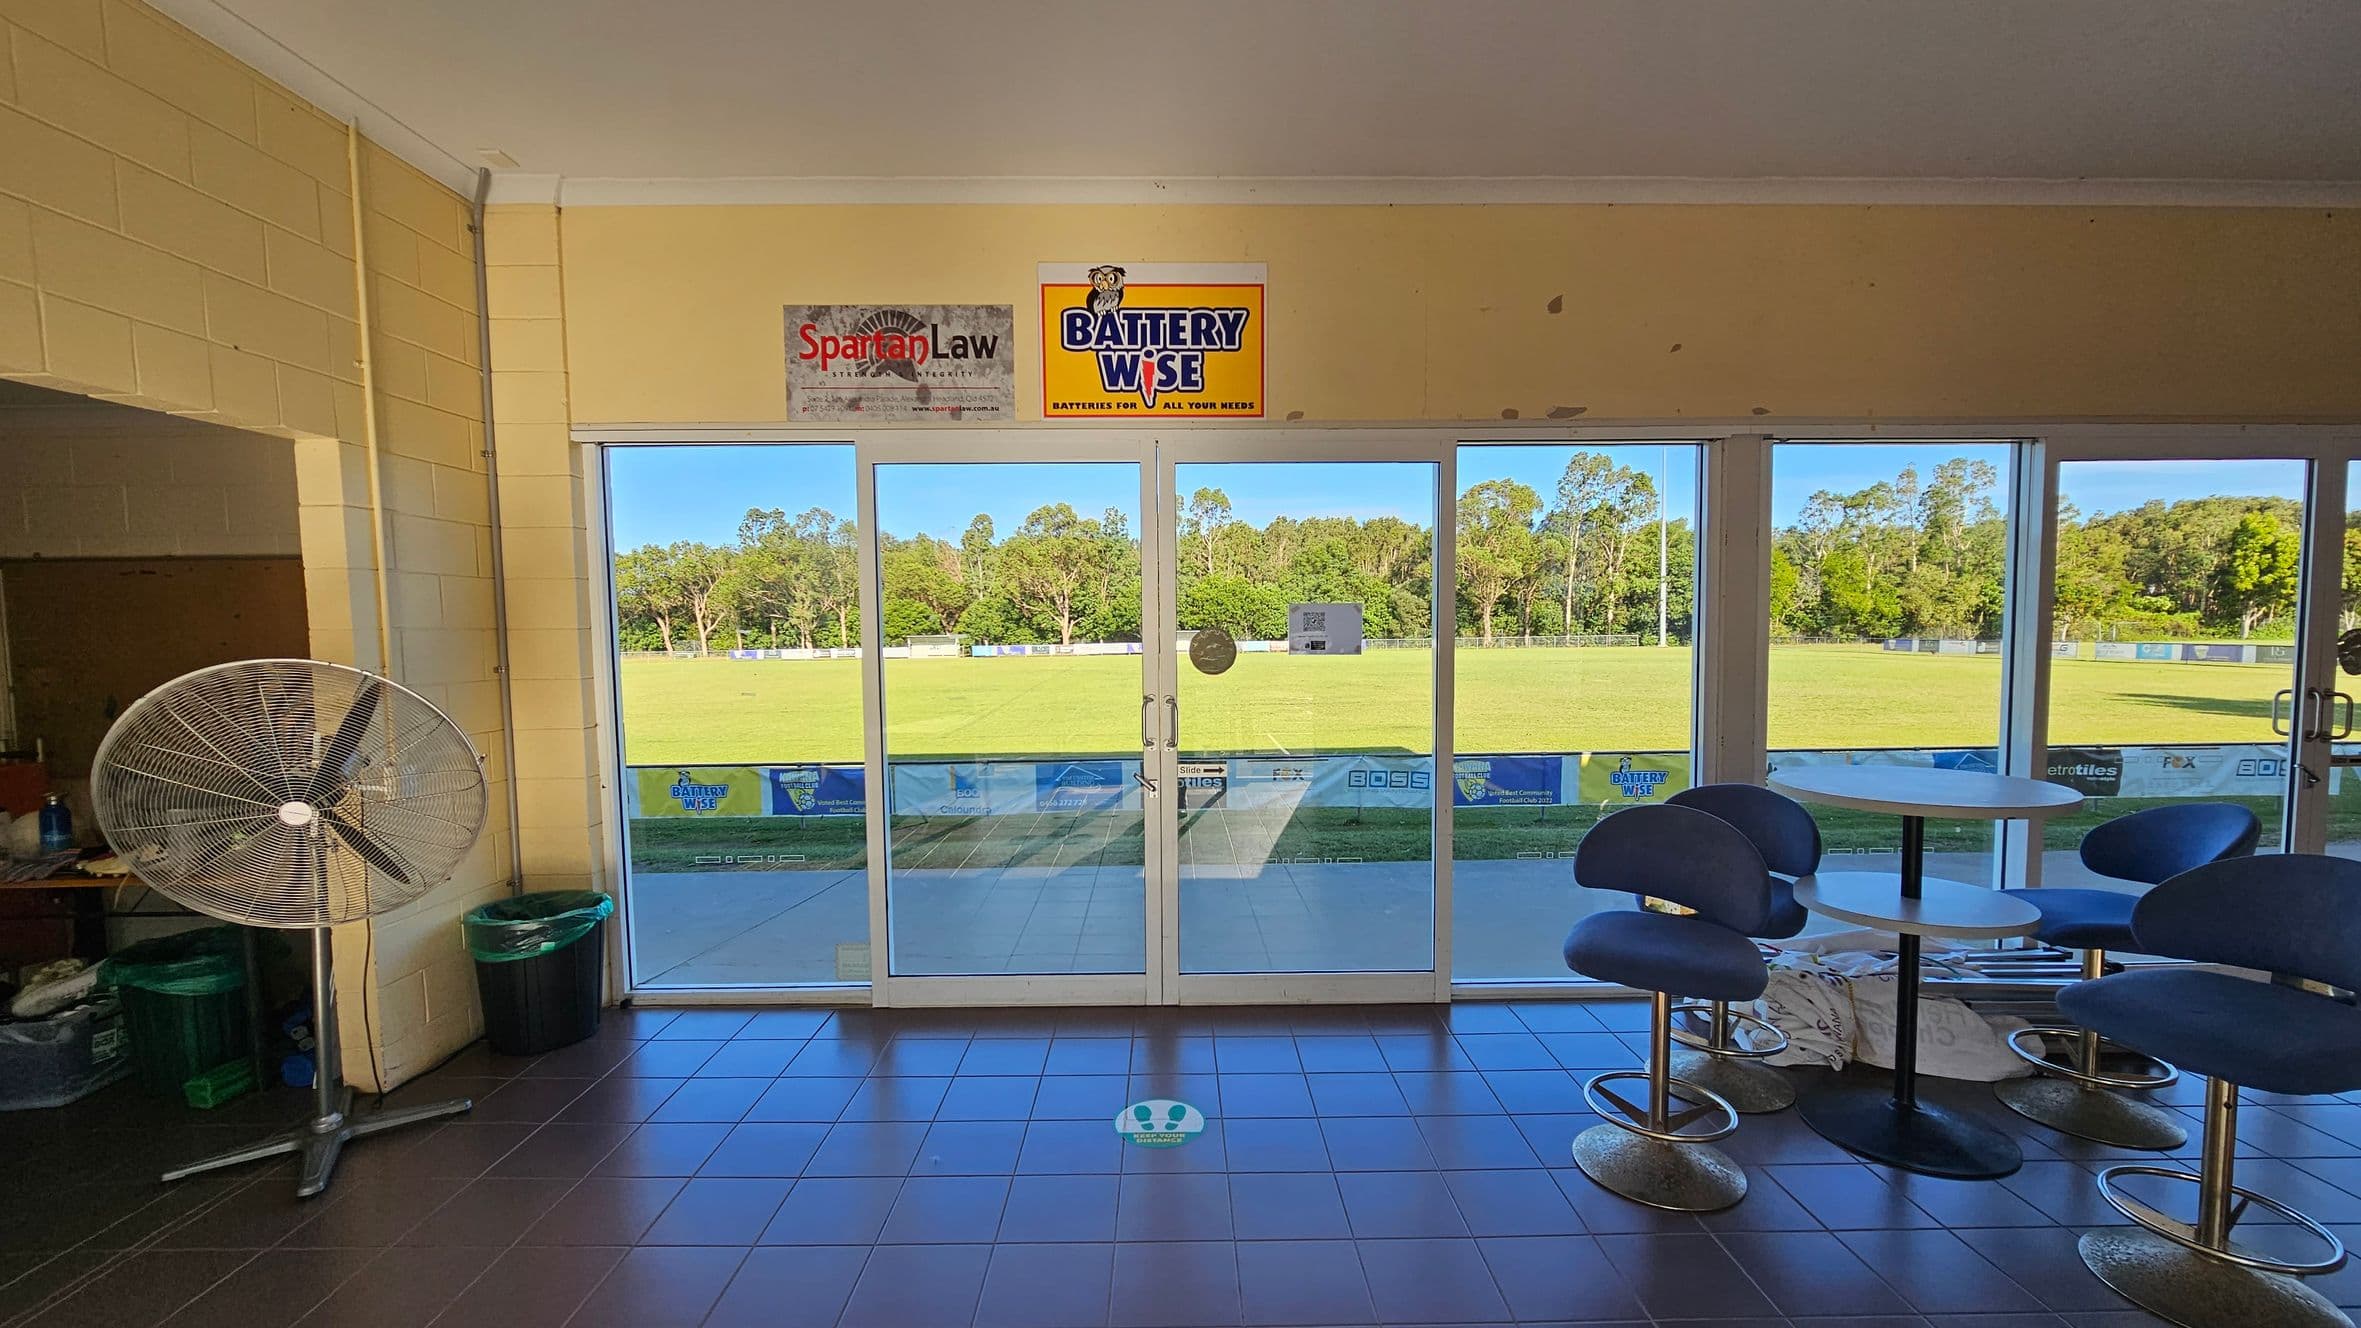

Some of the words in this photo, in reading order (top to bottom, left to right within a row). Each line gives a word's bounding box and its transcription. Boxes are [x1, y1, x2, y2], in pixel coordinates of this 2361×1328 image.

[1062, 308, 1249, 351] BATTERY
[912, 405, 1000, 413] www.spartanlaw.com.au
[1052, 401, 1113, 410] BATTERIES
[1116, 401, 1138, 410] FOR
[1163, 401, 1184, 410] ALL
[1188, 401, 1217, 410] YOUR
[1220, 401, 1255, 410] NEEDS
[1179, 765, 1202, 774] Slide
[1348, 770, 1430, 789] BOSS
[1610, 771, 1669, 785] BATTERY
[670, 784, 729, 798] BATTERY
[940, 805, 992, 815] Caloundra
